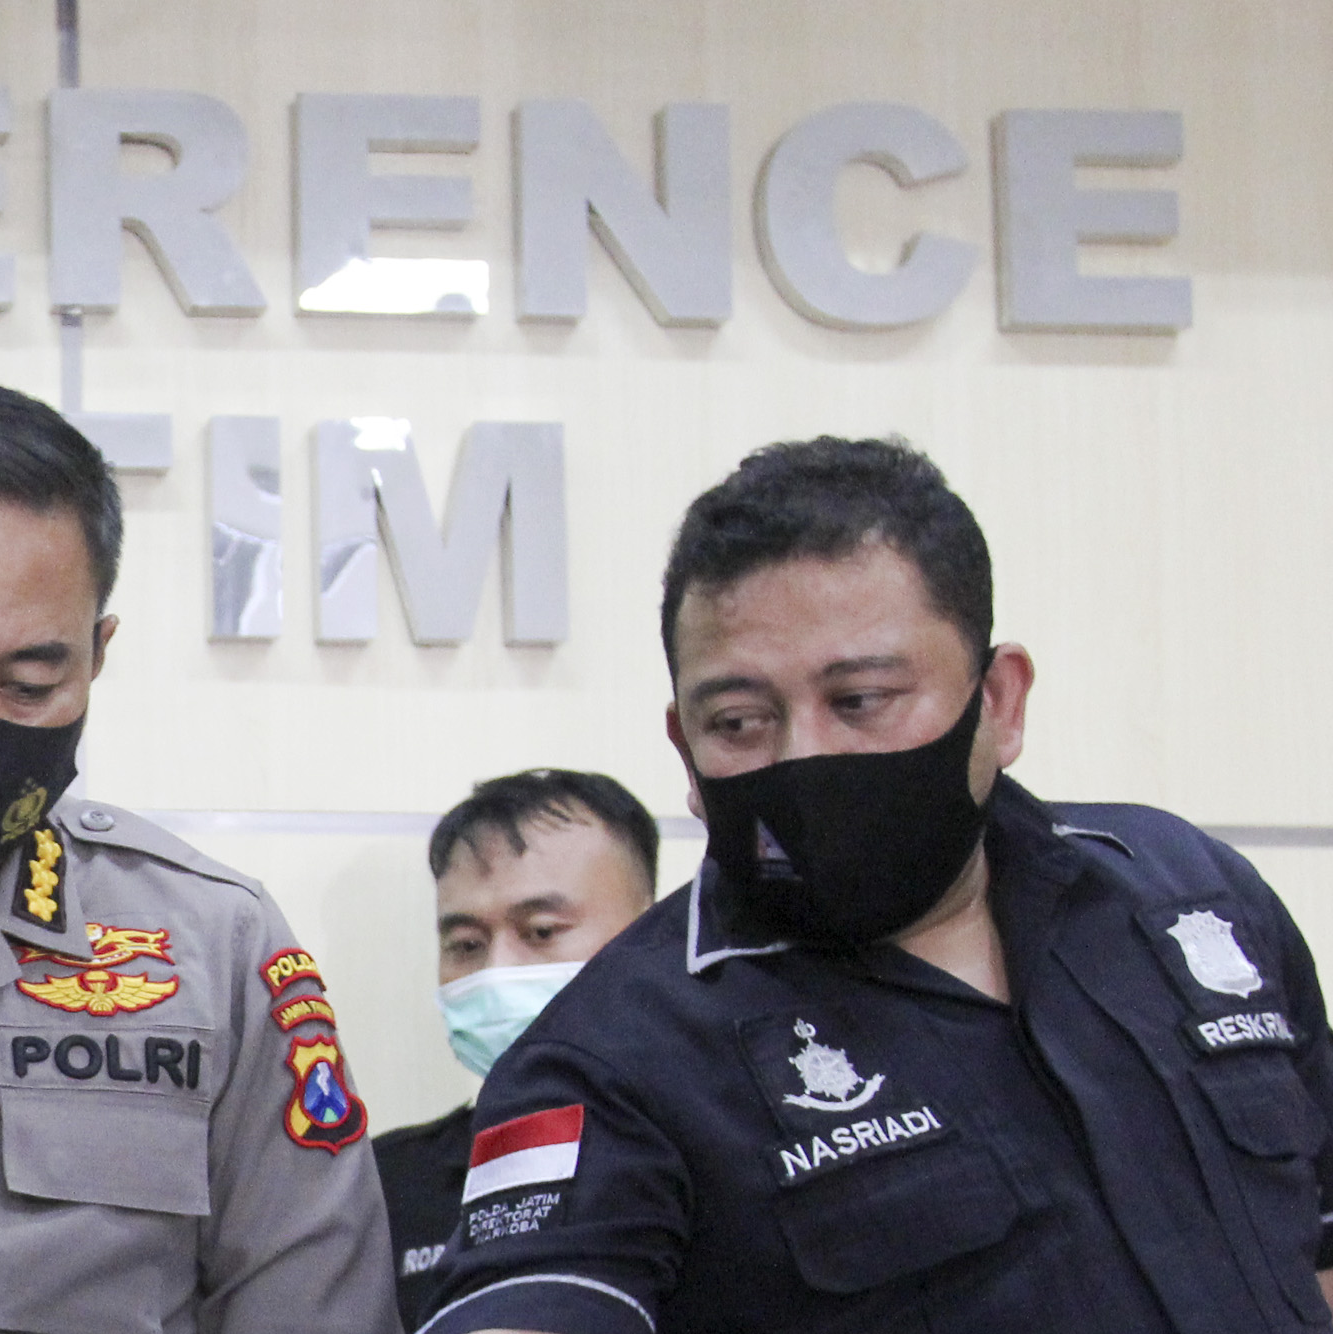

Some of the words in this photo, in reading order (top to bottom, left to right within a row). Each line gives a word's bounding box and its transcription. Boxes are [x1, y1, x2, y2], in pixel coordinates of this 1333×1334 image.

[11, 1033, 201, 1090] POLRI
[779, 1105, 943, 1177] NASRIADI
[468, 1203, 510, 1225] POLDA
[515, 1192, 561, 1210] JATIM
[469, 1205, 553, 1238] DIREKTORAT
